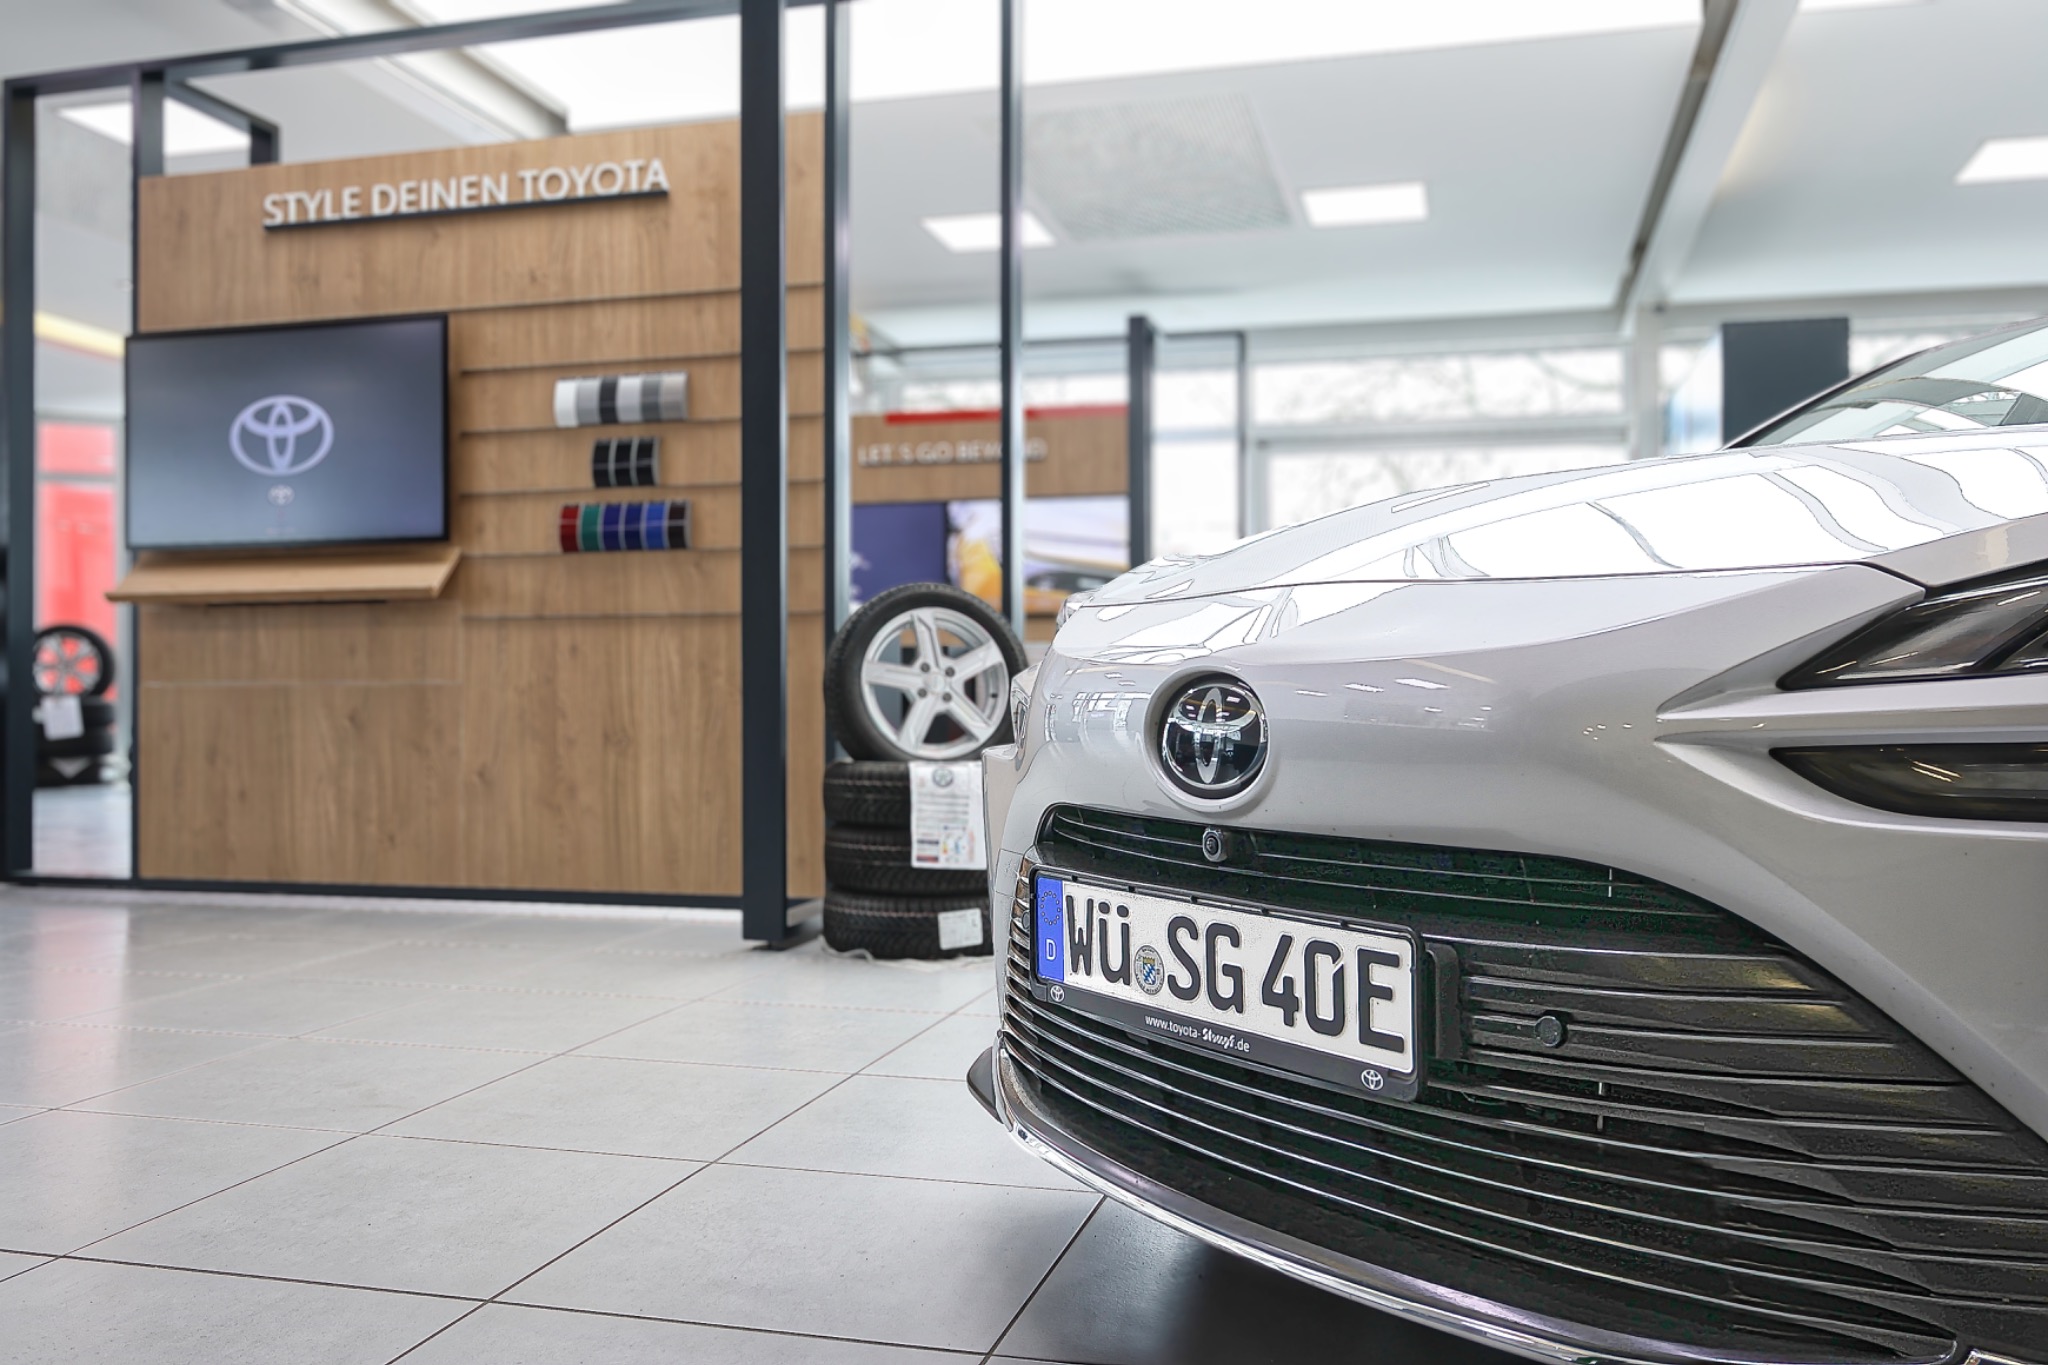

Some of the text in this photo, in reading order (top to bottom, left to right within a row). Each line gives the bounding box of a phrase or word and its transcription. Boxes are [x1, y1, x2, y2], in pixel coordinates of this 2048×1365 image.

[262, 158, 670, 227] STYLE DEINEN TOYOTA
[915, 440, 954, 465] GO
[955, 436, 1049, 465] BEYD
[1045, 937, 1056, 961] D
[1065, 894, 1131, 986] WÜ
[1167, 915, 1244, 1015] SG
[1261, 933, 1405, 1054] 40E
